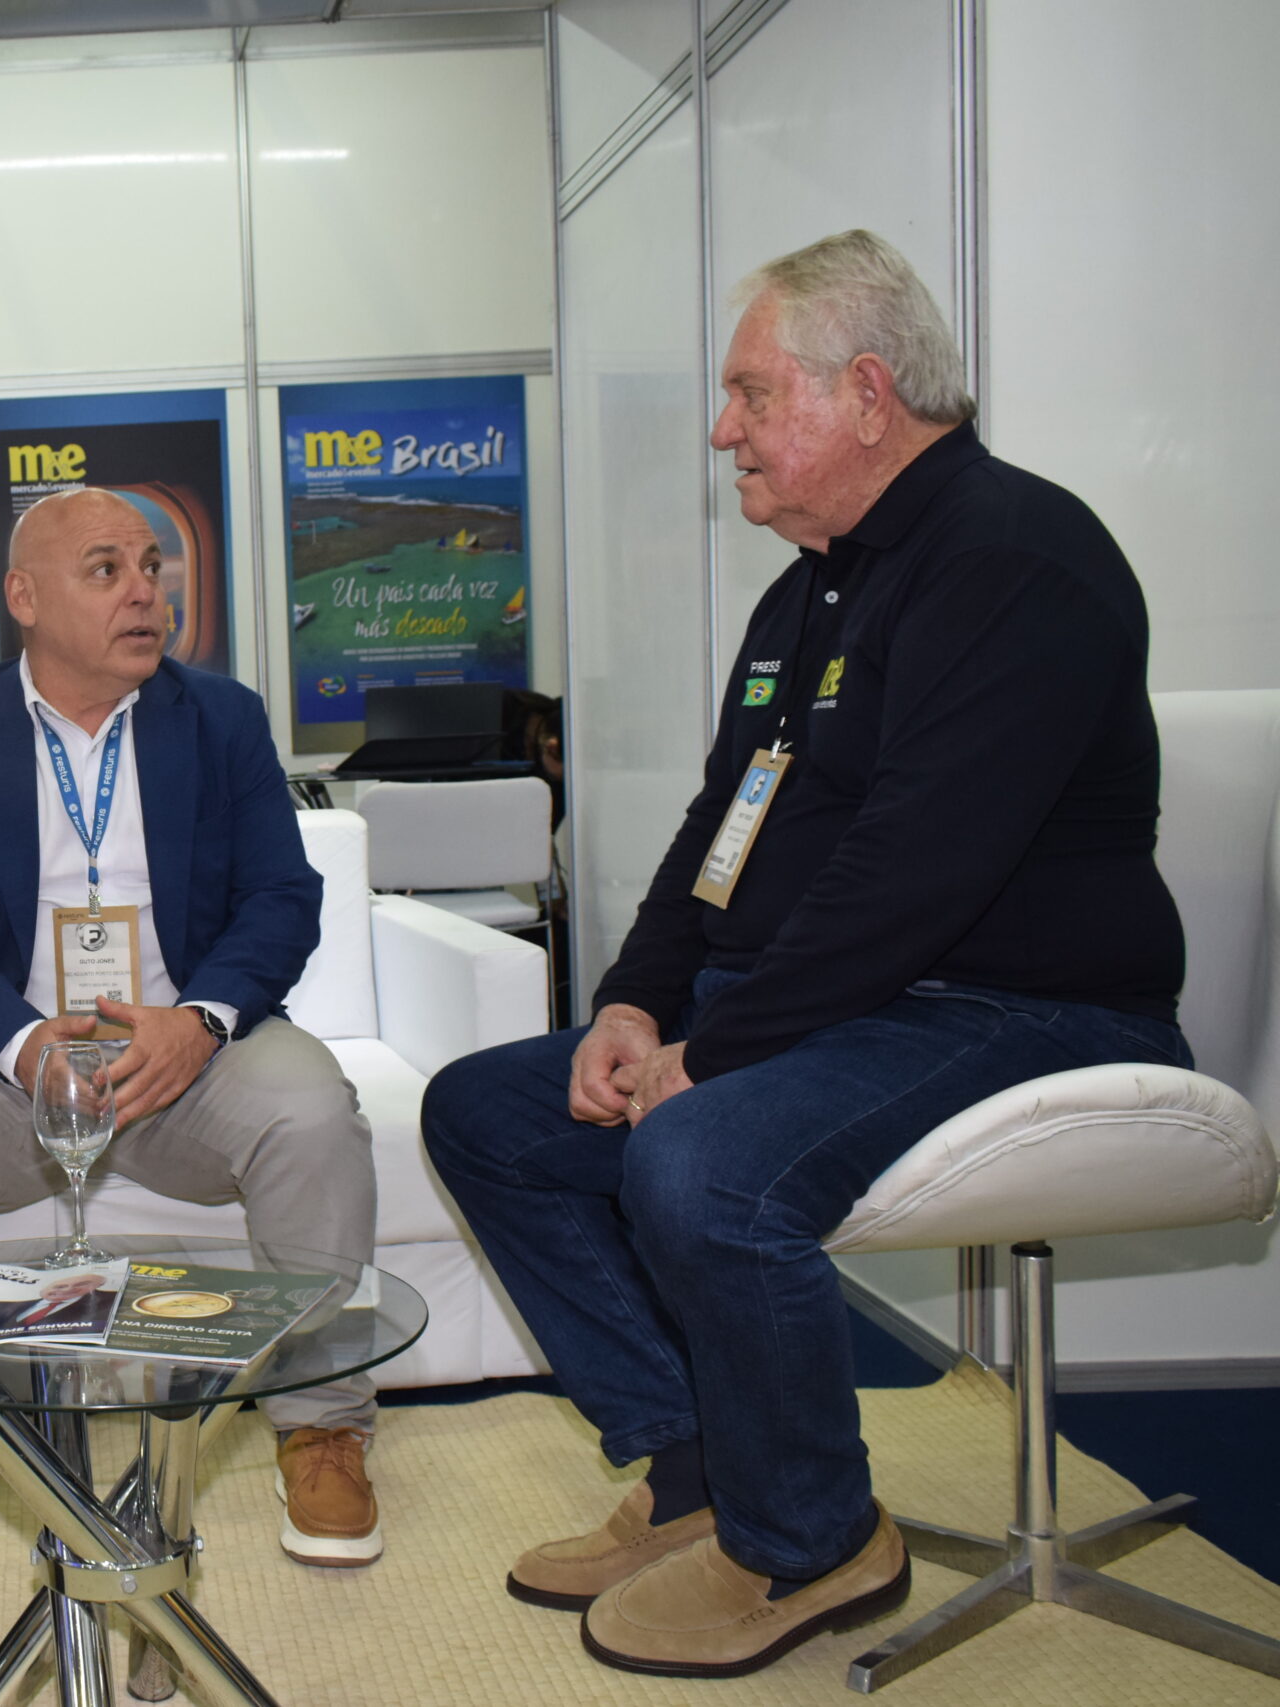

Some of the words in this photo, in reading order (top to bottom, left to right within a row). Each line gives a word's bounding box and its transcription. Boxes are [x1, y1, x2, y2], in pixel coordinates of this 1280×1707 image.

[8, 443, 87, 482] m&e
[304, 429, 383, 467] m&e
[389, 425, 506, 475] Brasil
[332, 577, 370, 608] Un
[419, 573, 464, 602] cada
[469, 581, 499, 599] vez
[395, 607, 469, 638] deseado
[750, 660, 782, 674] PRESS
[55, 755, 72, 793] Festuris
[103, 747, 116, 785] Festuris
[94, 807, 107, 846] Festuris
[28, 1321, 93, 1331] SCHWAM
[121, 1319, 141, 1327] NA
[208, 1328, 253, 1337] CERTA
